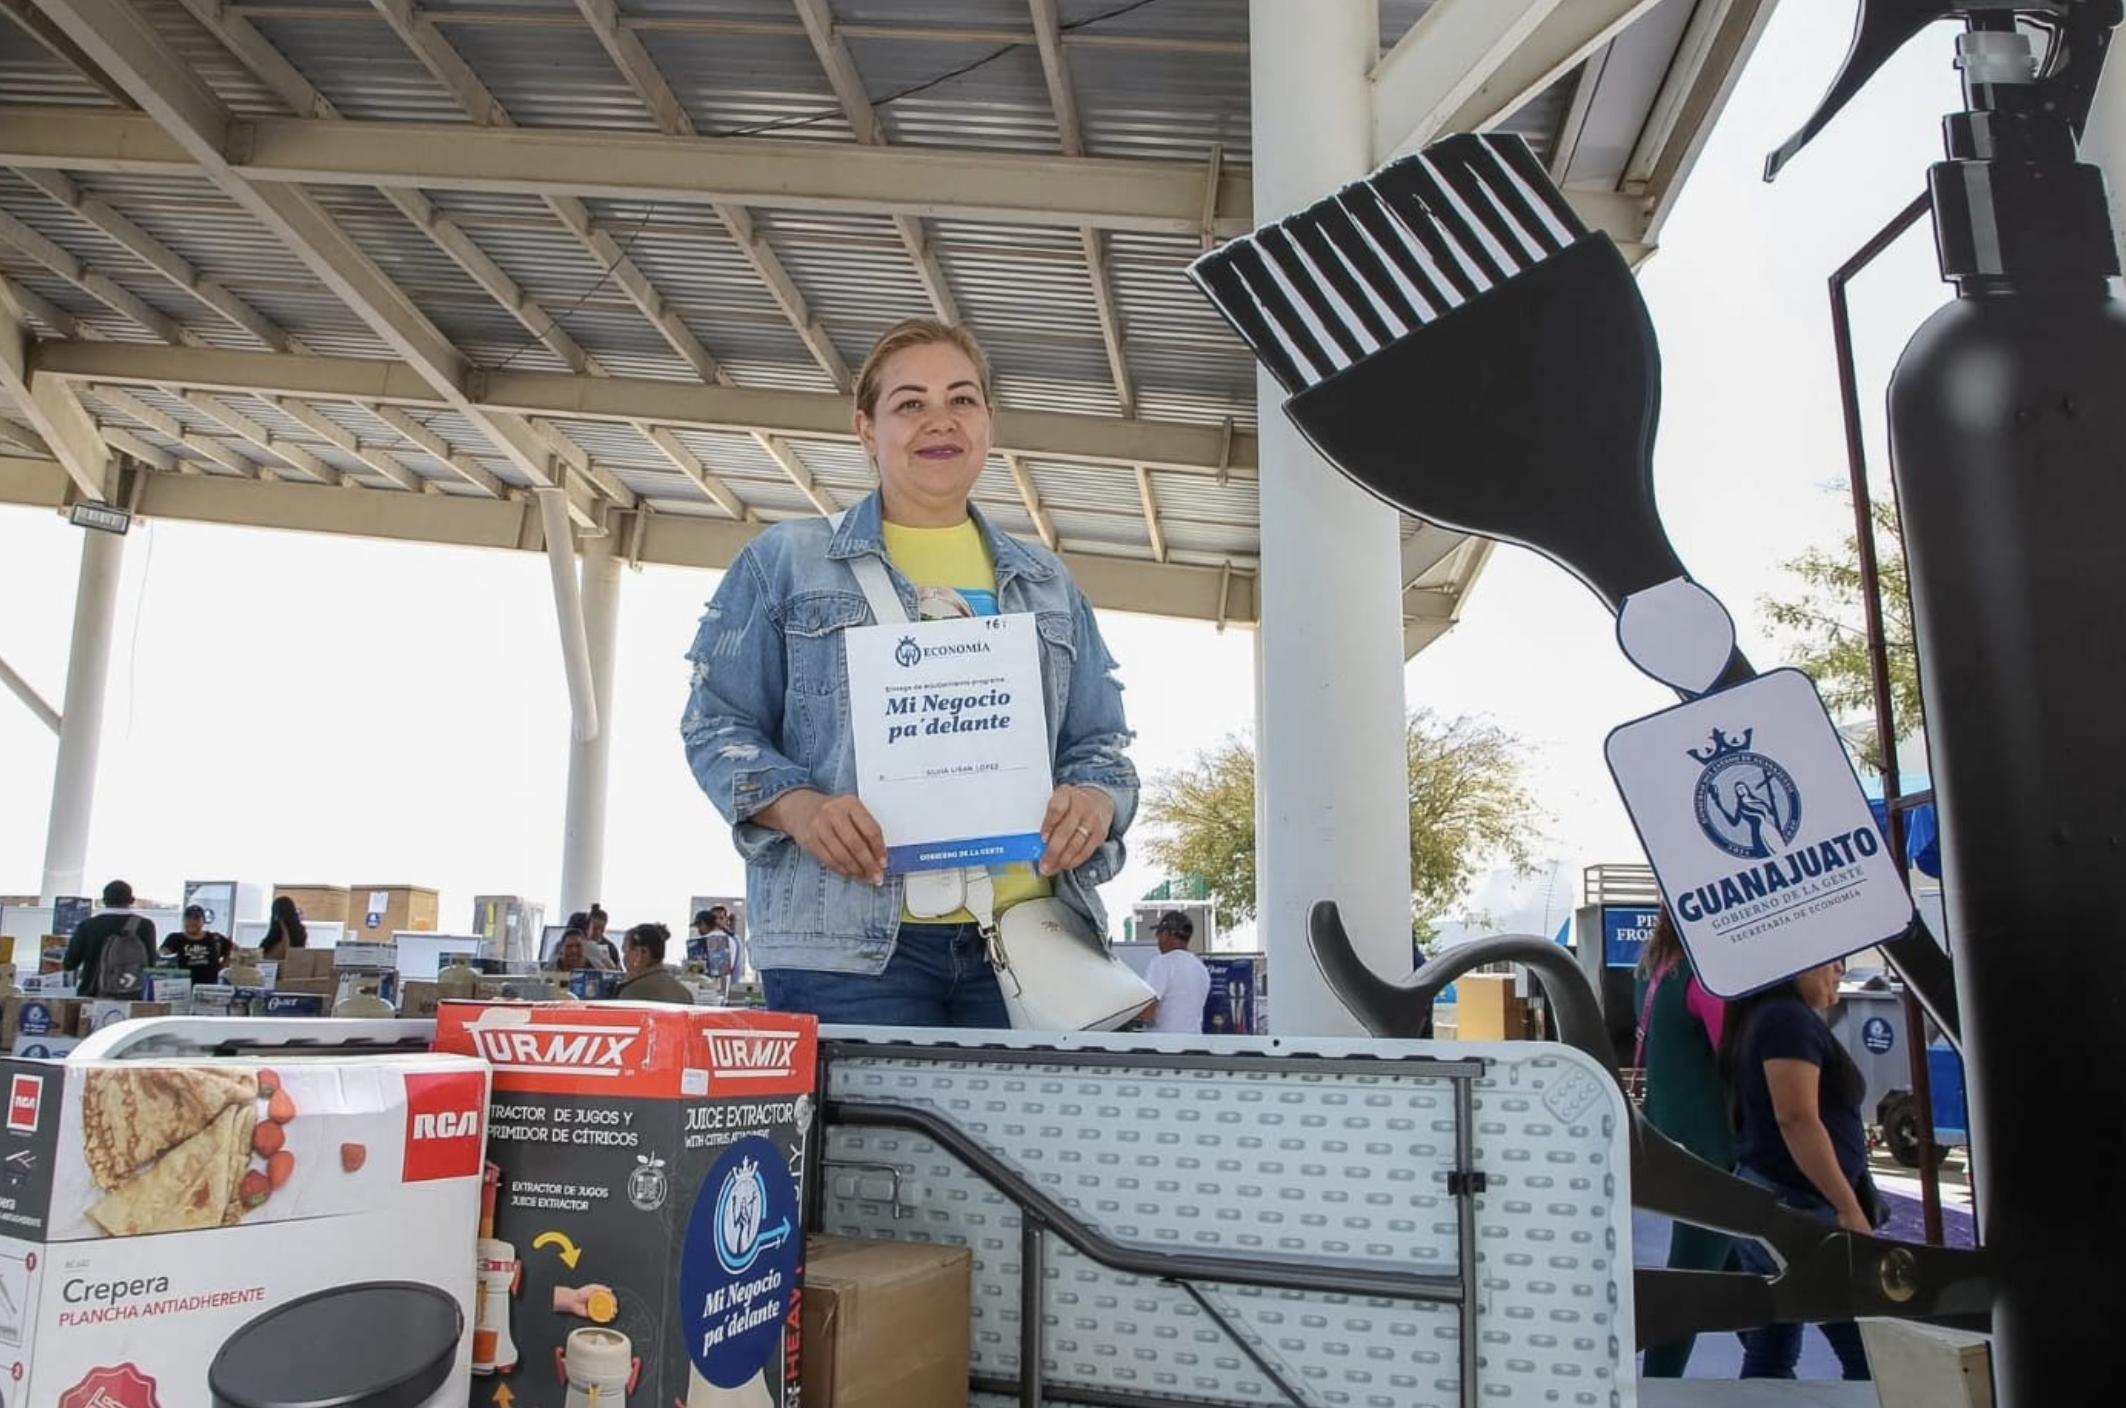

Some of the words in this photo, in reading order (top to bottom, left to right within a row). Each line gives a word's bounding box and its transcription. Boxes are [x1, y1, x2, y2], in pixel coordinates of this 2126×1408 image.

[923, 641, 991, 658] ECONOMÍA
[885, 696, 916, 716] Mi
[922, 689, 1011, 715] Negocio
[1677, 827, 1878, 922] GUANAJUATO
[1711, 899, 1779, 930] GOBIERNO
[1783, 890, 1799, 904] DE
[1802, 883, 1821, 897] LA
[1822, 867, 1865, 888] GENTE
[1730, 915, 1791, 944] SECRETARÍA
[1794, 909, 1807, 921] DE
[1809, 889, 1861, 914] ECONOMÍA
[461, 1022, 641, 1068] TURMIX
[702, 1029, 800, 1068] TURMIX
[412, 1110, 478, 1140] RCA
[490, 1104, 546, 1121] TRACTOR
[554, 1108, 571, 1122] DE
[573, 1108, 620, 1125] JUGOS
[622, 1112, 634, 1126] Y
[684, 1105, 725, 1131] JUICE
[726, 1103, 794, 1127] EXTRACTOR
[487, 1124, 548, 1142] PRIMIDOR
[552, 1128, 569, 1143] DE
[572, 1128, 639, 1147] CÍTRICOS
[512, 1181, 562, 1196] EXTRACTOR
[563, 1184, 577, 1197] DE
[578, 1187, 609, 1199] JUGOS
[538, 1199, 589, 1212] EXTRACTOR
[63, 1275, 169, 1306] Crepera
[702, 1287, 726, 1318] Mi
[726, 1268, 781, 1307] Negocio
[59, 1303, 138, 1326] PLANCHA
[142, 1287, 265, 1317] ANTIADHERENTE
